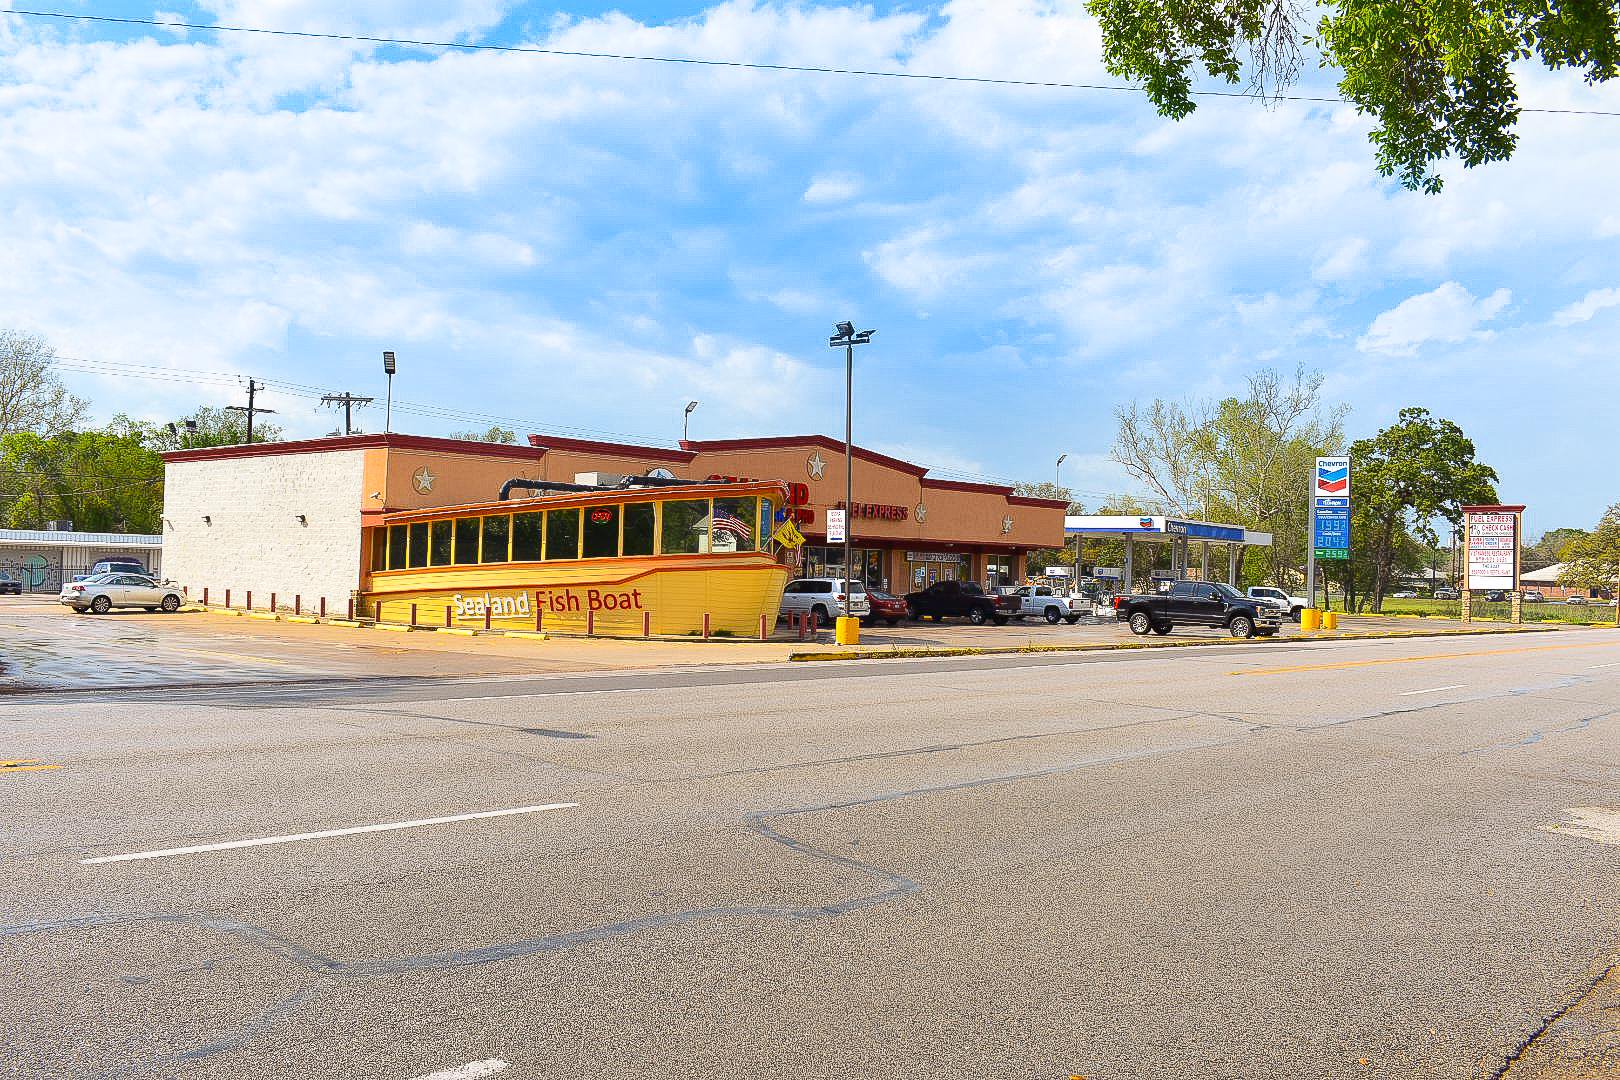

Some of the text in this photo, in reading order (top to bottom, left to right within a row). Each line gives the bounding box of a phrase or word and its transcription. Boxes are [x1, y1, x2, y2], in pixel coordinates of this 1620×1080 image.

[865, 503, 908, 520] EXPRESS
[453, 589, 643, 615] Sealand Fish Boat
